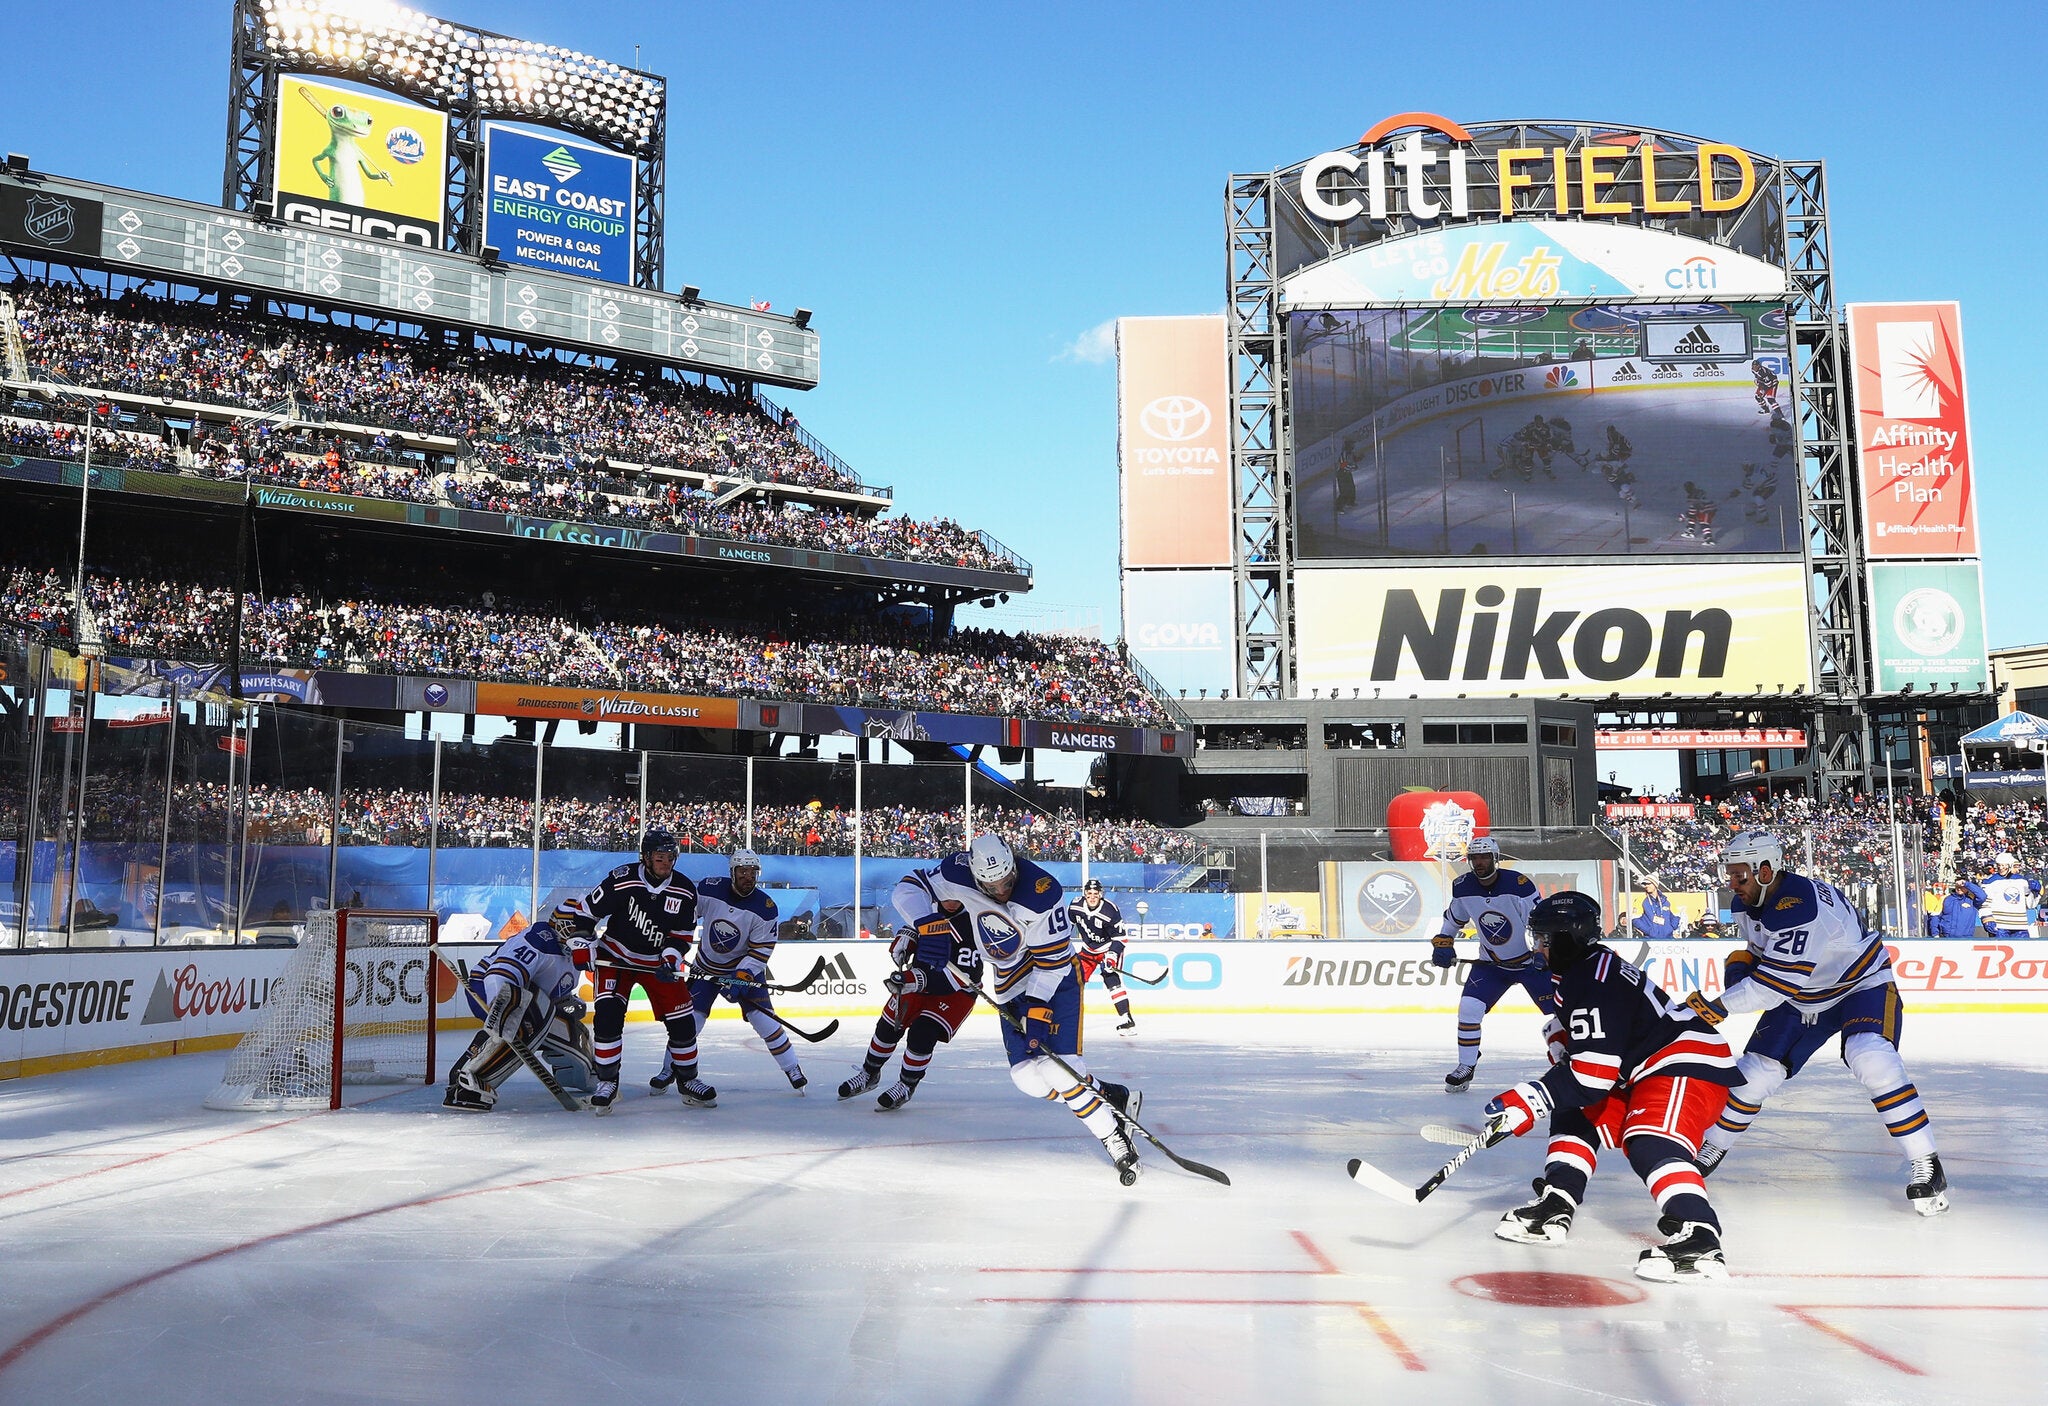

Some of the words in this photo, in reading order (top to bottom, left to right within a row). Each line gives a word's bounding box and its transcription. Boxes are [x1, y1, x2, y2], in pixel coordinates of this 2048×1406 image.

[1300, 131, 1469, 221] citi
[1497, 143, 1756, 217] FIELD
[494, 174, 550, 202] EAST
[555, 188, 626, 218] COAST
[36, 211, 66, 234] NHL
[284, 202, 431, 248] GEICO
[493, 199, 562, 225] ENERGY
[566, 213, 625, 238] GROUP
[330, 237, 401, 257] LEAGUE
[517, 229, 562, 248] POWER
[565, 238, 574, 250] &
[576, 240, 601, 256] GAS
[1368, 235, 1445, 269] LET'S
[516, 245, 602, 272] MECHANICAL
[1412, 257, 1450, 280] GO
[1431, 241, 1564, 300] Mets
[1665, 262, 1717, 290] citi
[592, 287, 671, 309] NATIONAL
[681, 303, 739, 321] LEAGUE
[1674, 342, 1721, 354] adidas
[1611, 373, 1642, 382] adidas
[1651, 370, 1683, 379] adidas
[1692, 369, 1725, 378] adidas
[1446, 373, 1526, 405] DISCOVER
[1871, 424, 1958, 452] Affinity
[1134, 447, 1221, 464] TOYOTA
[1879, 455, 1955, 477] Health
[256, 488, 309, 507] Winter
[309, 499, 356, 513] CLASSIC
[1894, 481, 1943, 503] Plan
[1887, 525, 1919, 535] Affinity
[1920, 525, 1947, 533] Health
[1948, 524, 1966, 533] Plan
[719, 547, 771, 563] RANGERS
[1138, 622, 1219, 647] GOYA
[1370, 584, 1733, 682] Nikon
[1926, 658, 1946, 666] THE
[516, 697, 579, 711] BRIDGESTONE
[595, 692, 652, 718] Winter
[652, 704, 701, 718] CLASSIC
[1051, 731, 1116, 749] RANGERS
[1623, 735, 1647, 745] JIM
[1652, 734, 1688, 745] BEAM
[1695, 734, 1760, 745] BOURBON
[1765, 733, 1794, 744] BAR
[1609, 806, 1624, 818] JIM
[1624, 806, 1644, 818] BEAM
[1656, 806, 1671, 818] JIM
[1671, 806, 1691, 818] BEAM
[986, 856, 997, 867] 19
[769, 920, 778, 937] 4
[1047, 906, 1069, 935] 19
[1125, 923, 1203, 940] GEICO
[573, 940, 592, 949] STX
[1773, 929, 1810, 956] 28
[513, 945, 537, 965] 40
[173, 963, 247, 1019] Coors
[718, 977, 750, 987] SURGEON
[805, 979, 867, 996] adidas
[1570, 1007, 1606, 1041] 51
